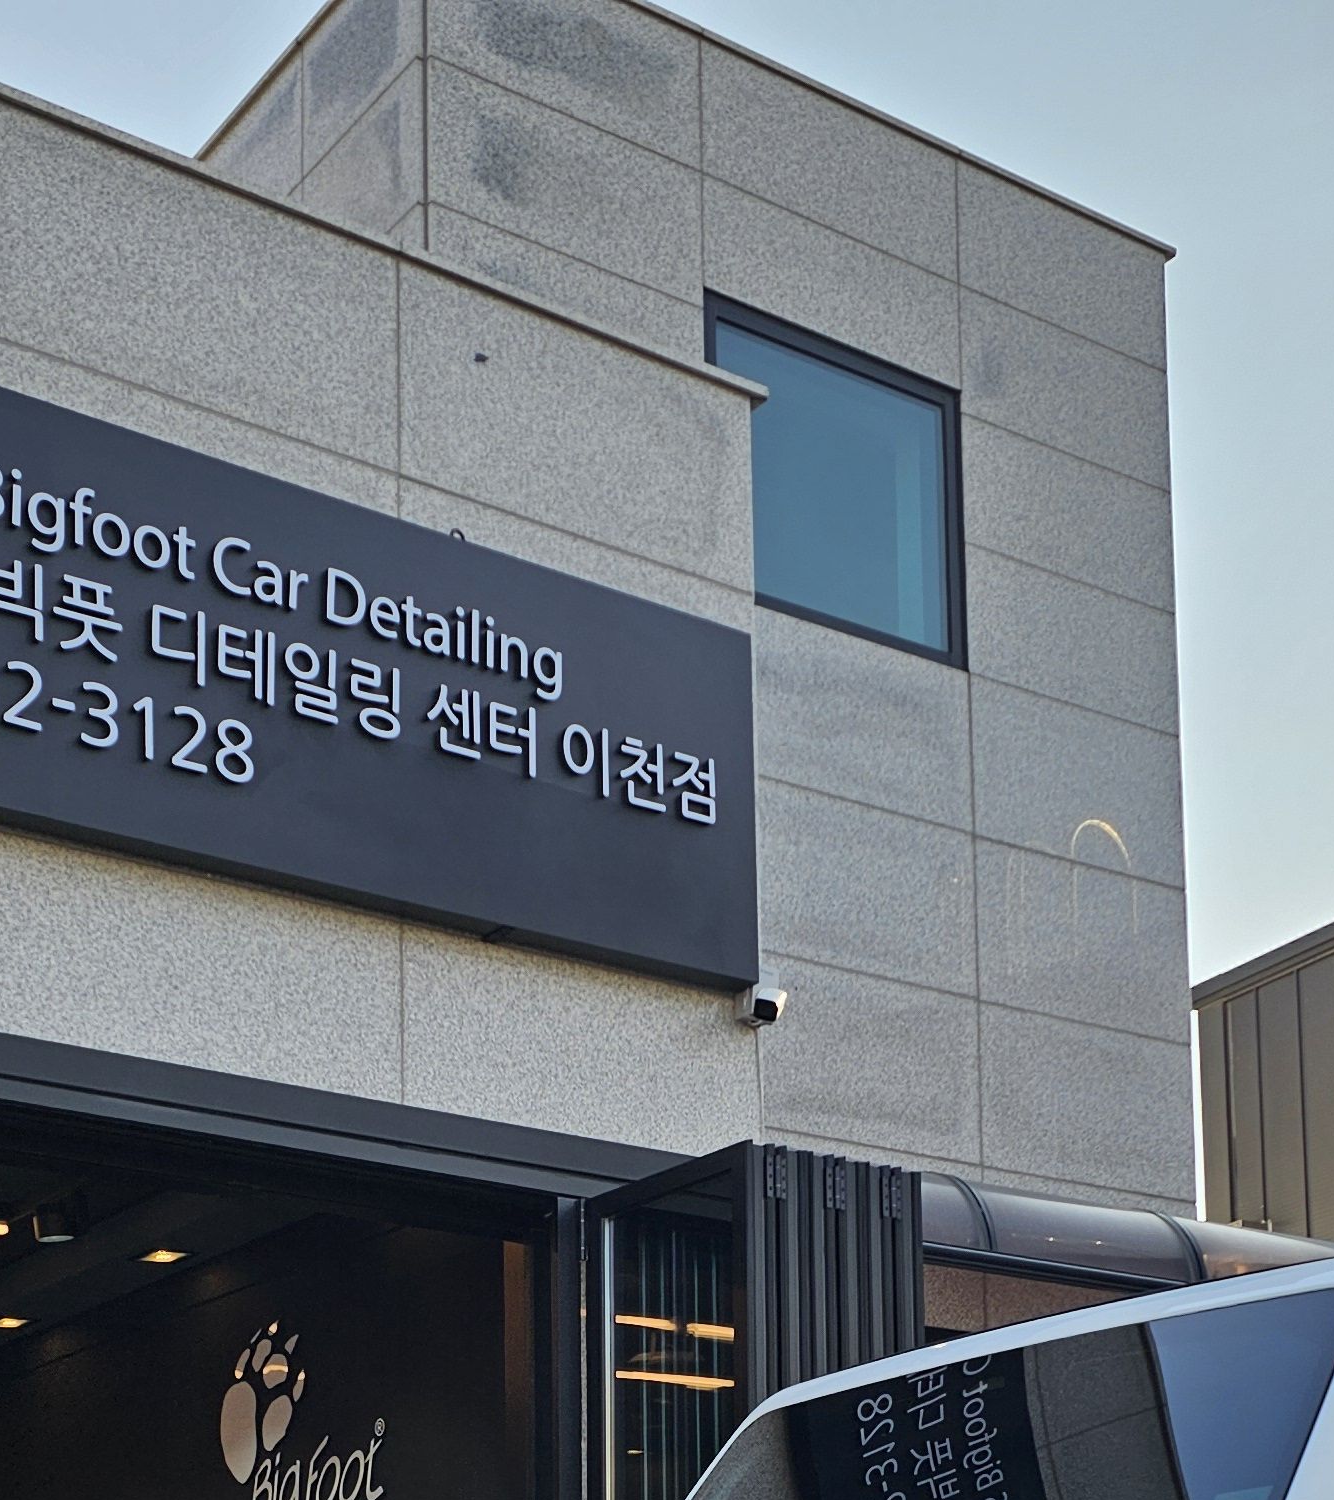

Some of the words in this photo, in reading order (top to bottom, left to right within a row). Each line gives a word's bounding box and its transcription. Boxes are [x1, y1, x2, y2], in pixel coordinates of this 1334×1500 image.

[150, 602, 402, 741] 디테일링
[426, 681, 537, 778] 센터
[562, 720, 717, 827] 이천점
[213, 536, 310, 612] Car
[325, 567, 563, 700] Detailing
